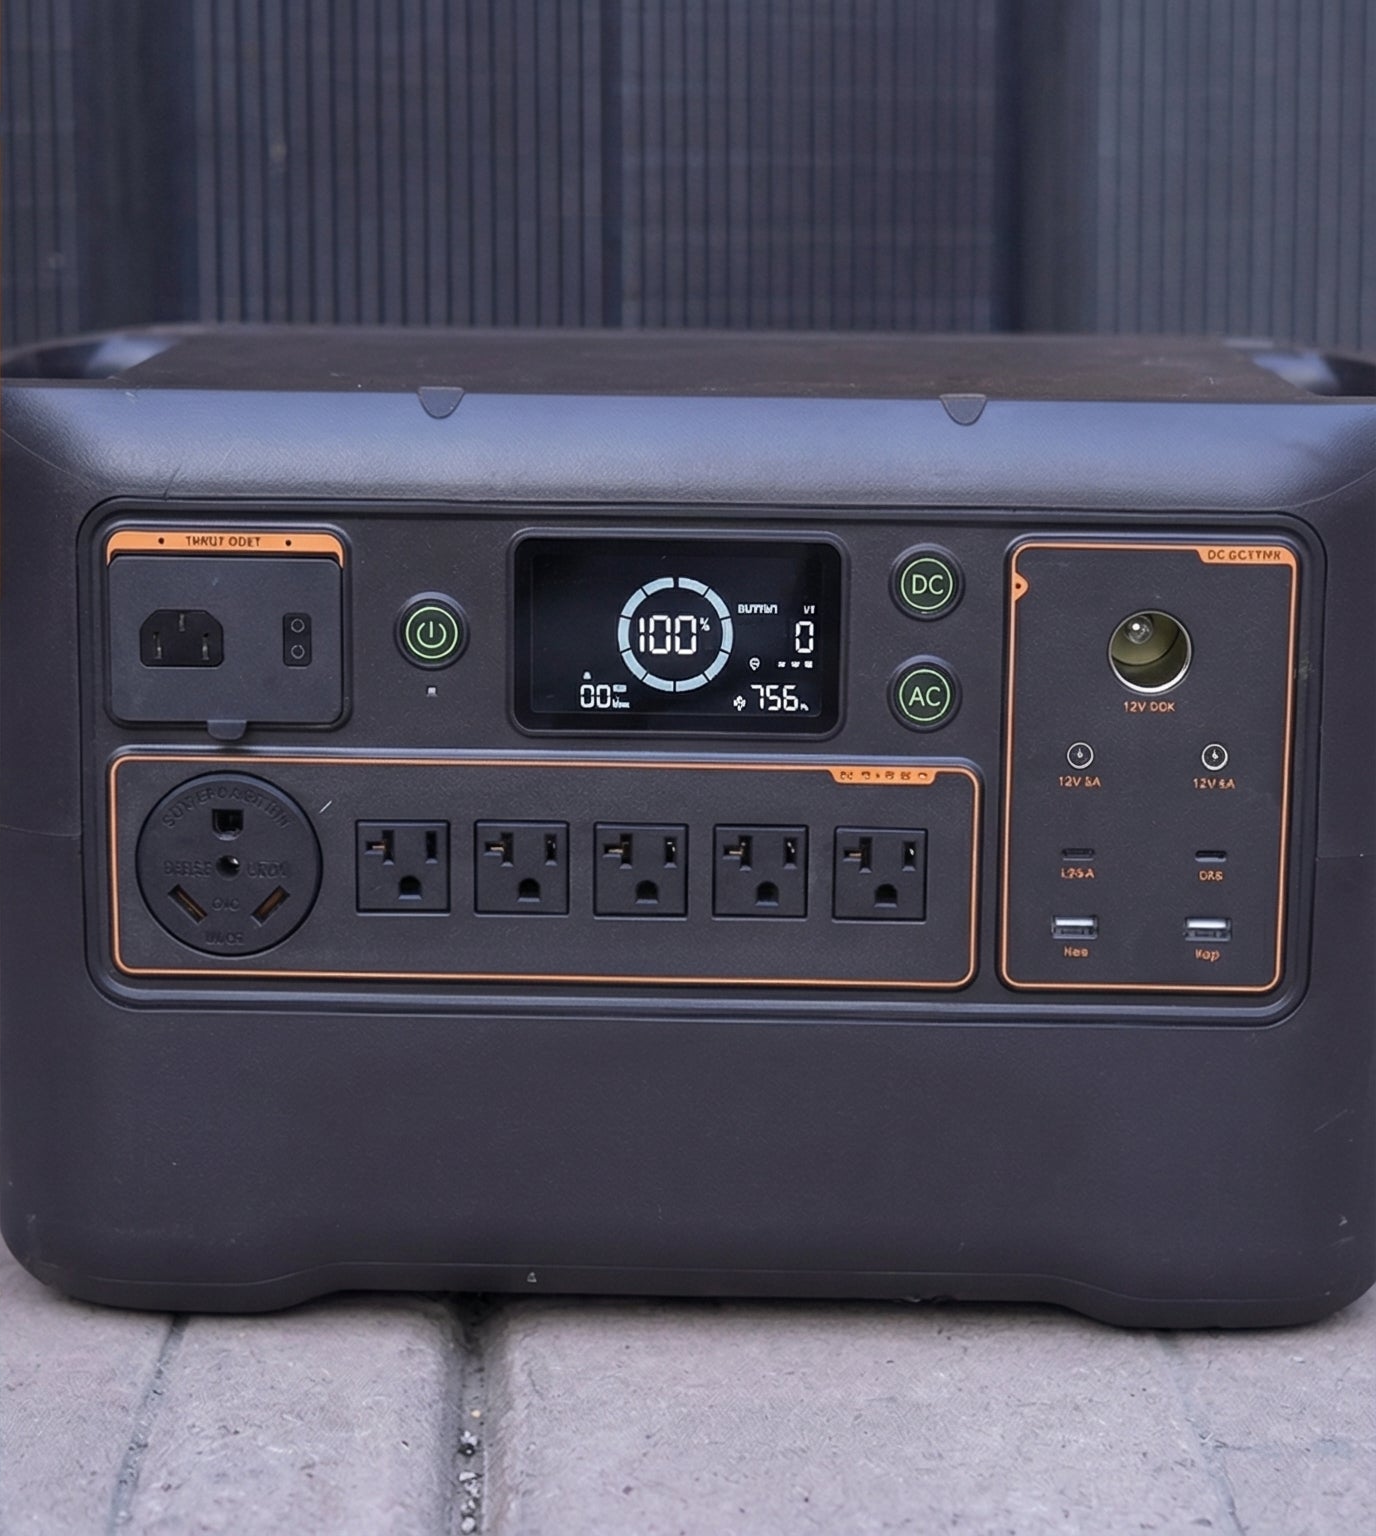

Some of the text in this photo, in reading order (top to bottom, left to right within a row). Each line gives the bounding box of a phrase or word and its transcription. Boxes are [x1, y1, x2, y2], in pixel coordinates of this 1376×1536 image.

[1207, 549, 1225, 560] DC
[911, 573, 944, 595] DC
[795, 620, 814, 653] 0
[908, 685, 941, 707] AC
[1123, 700, 1147, 712] 12V
[1059, 775, 1082, 787] 12V
[1193, 777, 1217, 789] 12V
